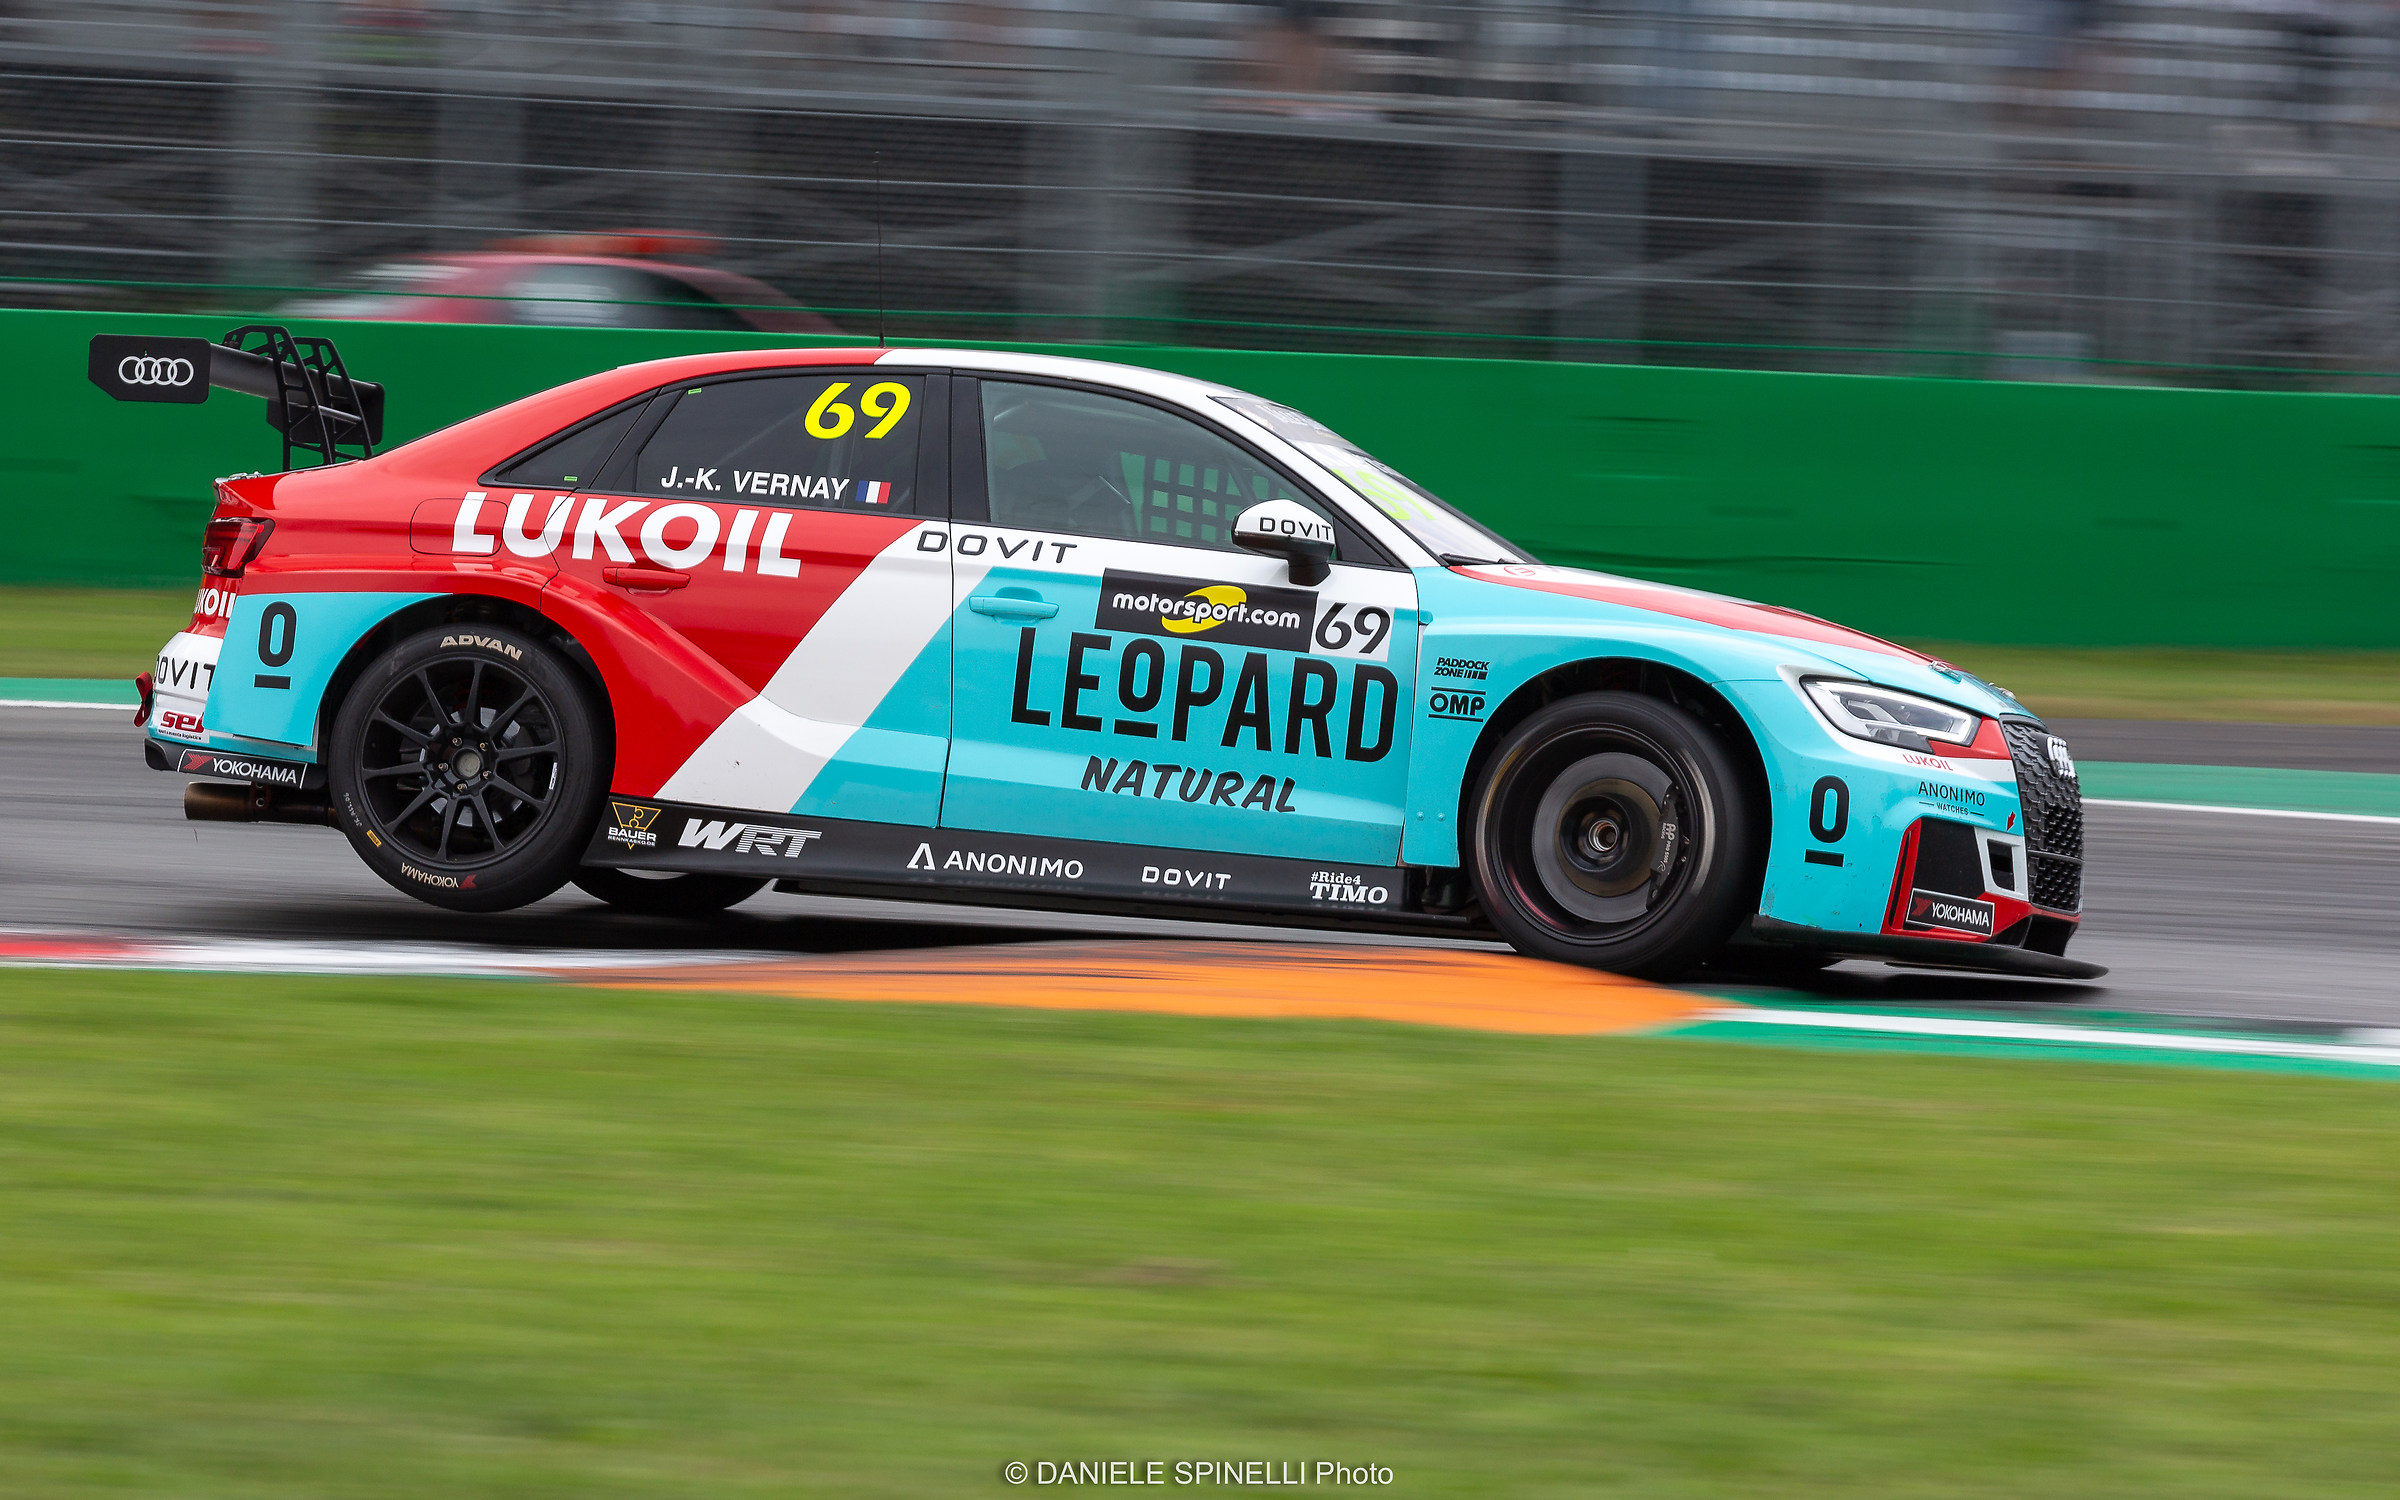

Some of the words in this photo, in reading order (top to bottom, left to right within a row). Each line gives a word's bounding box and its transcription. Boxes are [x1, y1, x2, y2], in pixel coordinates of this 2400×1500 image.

[804, 382, 911, 439] 69
[661, 466, 721, 491] J.-K.
[733, 470, 850, 500] VERNAY
[452, 491, 801, 578] LUKOIL
[1259, 517, 1331, 540] DOVIT
[916, 530, 1077, 563] DOVIT
[1112, 592, 1300, 629] motorsport.com
[1315, 602, 1391, 654] 69
[440, 634, 523, 661] ADVAN
[1434, 667, 1464, 677] ZONE
[1437, 657, 1490, 670] PADDOCK
[1011, 627, 1399, 762] LEOPARD
[1429, 693, 1485, 716] OMP
[213, 758, 297, 784] YOKOHAMA
[1903, 754, 1954, 771] LUKOIL
[1081, 755, 1296, 812] NATURAL
[1919, 781, 1985, 806] ANONIMO
[1937, 802, 1969, 815] WATCHES
[608, 826, 657, 842] BAUER
[678, 818, 822, 858] WRT
[401, 862, 459, 889] YOKOHAMA
[943, 850, 1084, 880] ANONIMO
[1141, 866, 1232, 890] DOVIT
[1311, 871, 1361, 886] #Ride4
[1309, 882, 1388, 905] TIMO
[1932, 902, 1990, 927] YOKOHAMA
